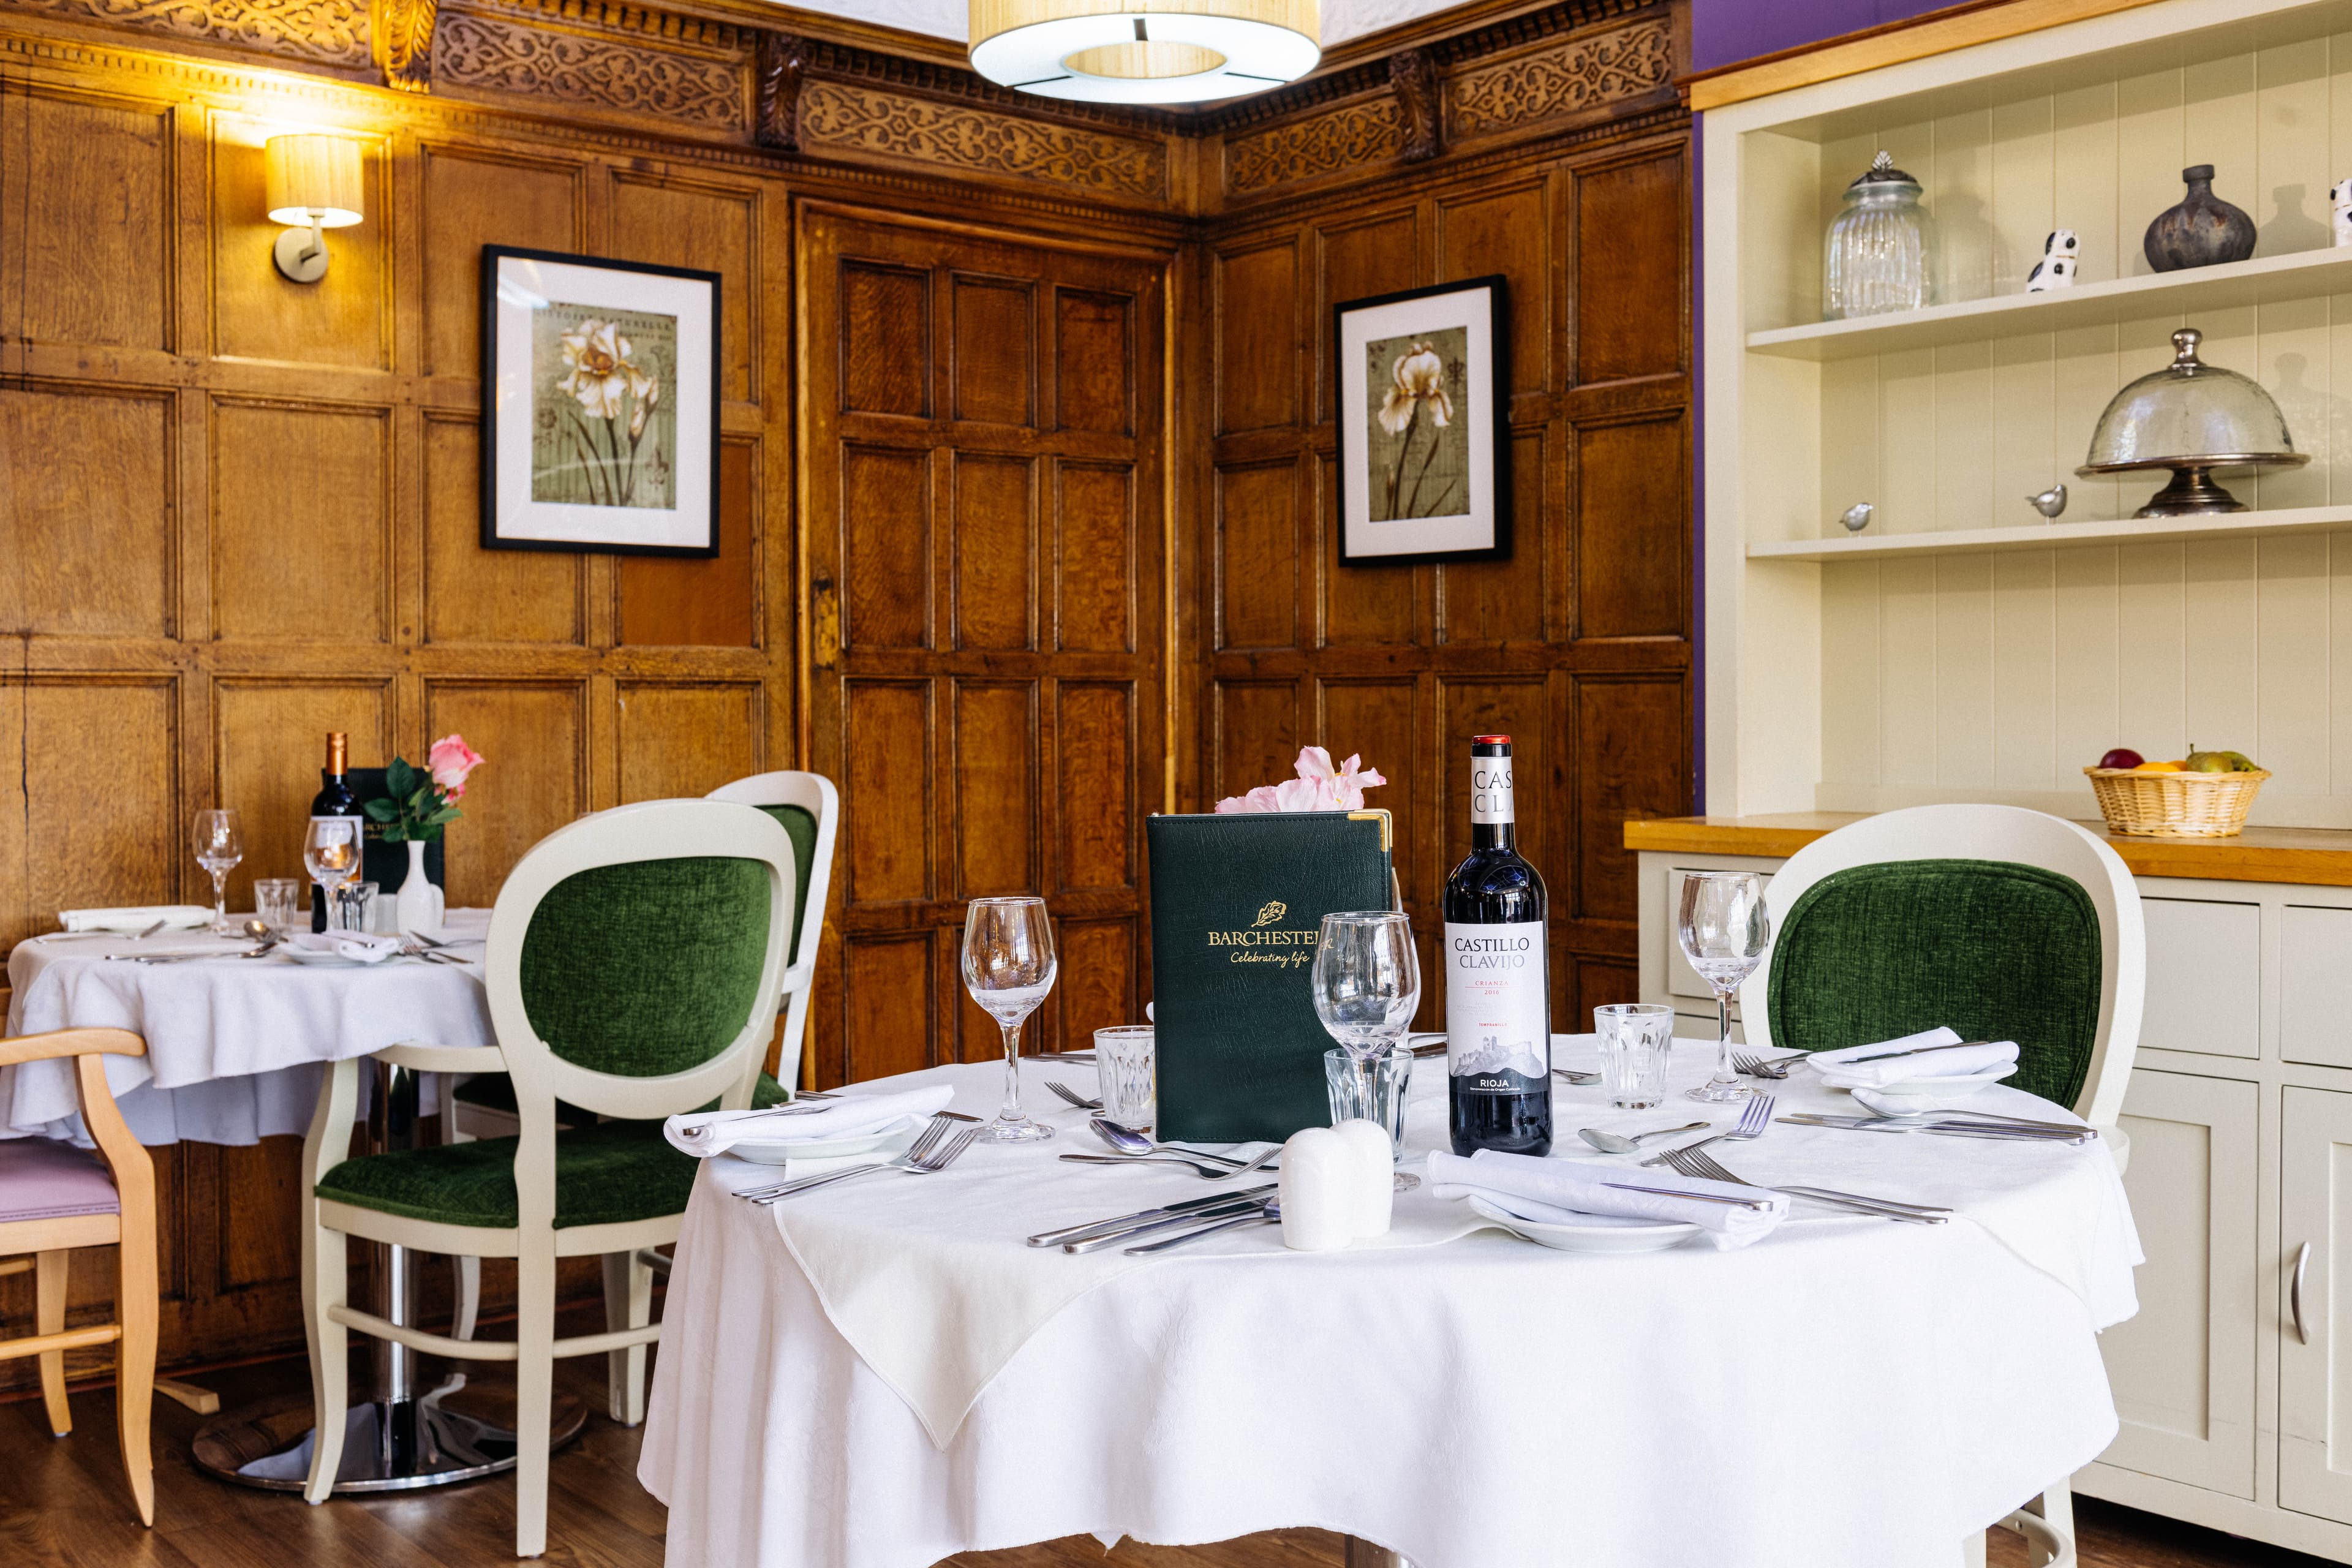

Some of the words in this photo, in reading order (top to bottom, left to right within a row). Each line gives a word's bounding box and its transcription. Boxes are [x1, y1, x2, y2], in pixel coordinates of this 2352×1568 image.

[1474, 771, 1512, 790] CAS
[1474, 794, 1513, 813] CL
[1455, 937, 1529, 952] CASTILLO
[1231, 951, 1289, 968] Celebrating
[1291, 951, 1310, 968] life
[1460, 954, 1525, 970] CLAVIJO
